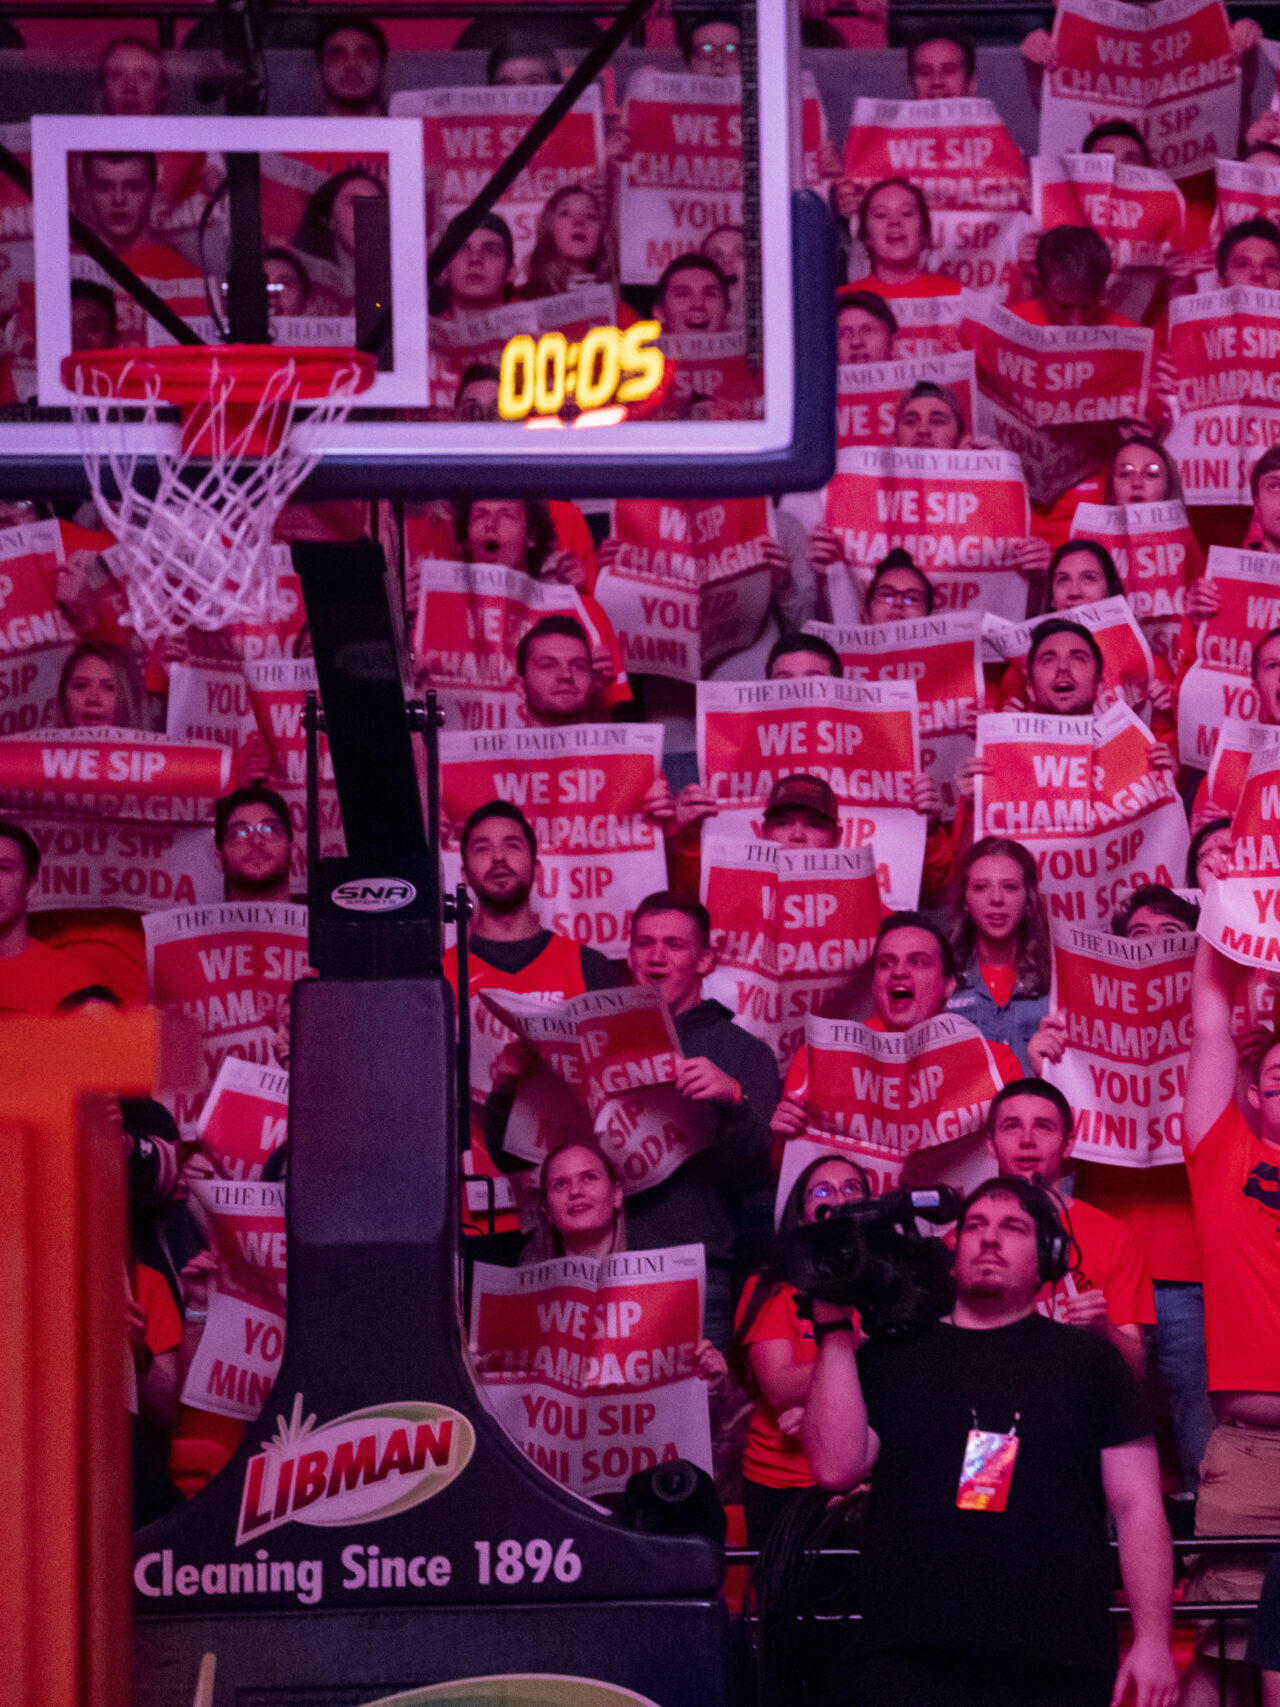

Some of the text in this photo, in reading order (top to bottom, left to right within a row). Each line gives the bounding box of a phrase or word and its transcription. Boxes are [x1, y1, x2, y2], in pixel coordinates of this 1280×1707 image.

[1096, 32, 1191, 66] WE SIP
[442, 127, 500, 158] WE
[673, 115, 723, 146] WE
[887, 137, 992, 170] WE SIP
[498, 321, 664, 419] 00:05
[1000, 348, 1095, 390] WE SIP
[1194, 415, 1236, 447] YOU
[877, 491, 977, 522] WE SIP
[1138, 543, 1186, 580] SIP
[640, 596, 698, 632] YOU
[737, 682, 882, 704] THE DAILY ILLINI
[470, 730, 627, 753] THE DAILY ILLINI
[757, 721, 862, 757] WE SIP
[1013, 718, 1048, 736] THE
[42, 748, 165, 782] WE SIP
[1033, 756, 1088, 788] WE
[494, 768, 606, 806] WE SIP
[38, 827, 174, 860] YOU SIP
[1035, 828, 1146, 890] YOU SIP
[108, 865, 197, 905] SODA
[570, 866, 613, 902] SIP
[175, 908, 274, 930] THE DAILY
[785, 895, 838, 931] SIP
[198, 945, 252, 983] WE
[1071, 936, 1153, 967] THE DAILY
[1090, 968, 1192, 1015] WE SIP
[850, 1065, 945, 1110] WE SIP
[1088, 1061, 1149, 1109] YOU
[210, 1186, 256, 1206] THE
[520, 1256, 664, 1286] THE ILLINI
[537, 1300, 642, 1342] WE SIP
[521, 1394, 657, 1441] YOU SIP
[238, 1420, 455, 1545] LIBMAN
[134, 1539, 583, 1604] Cleaning Since 1896
